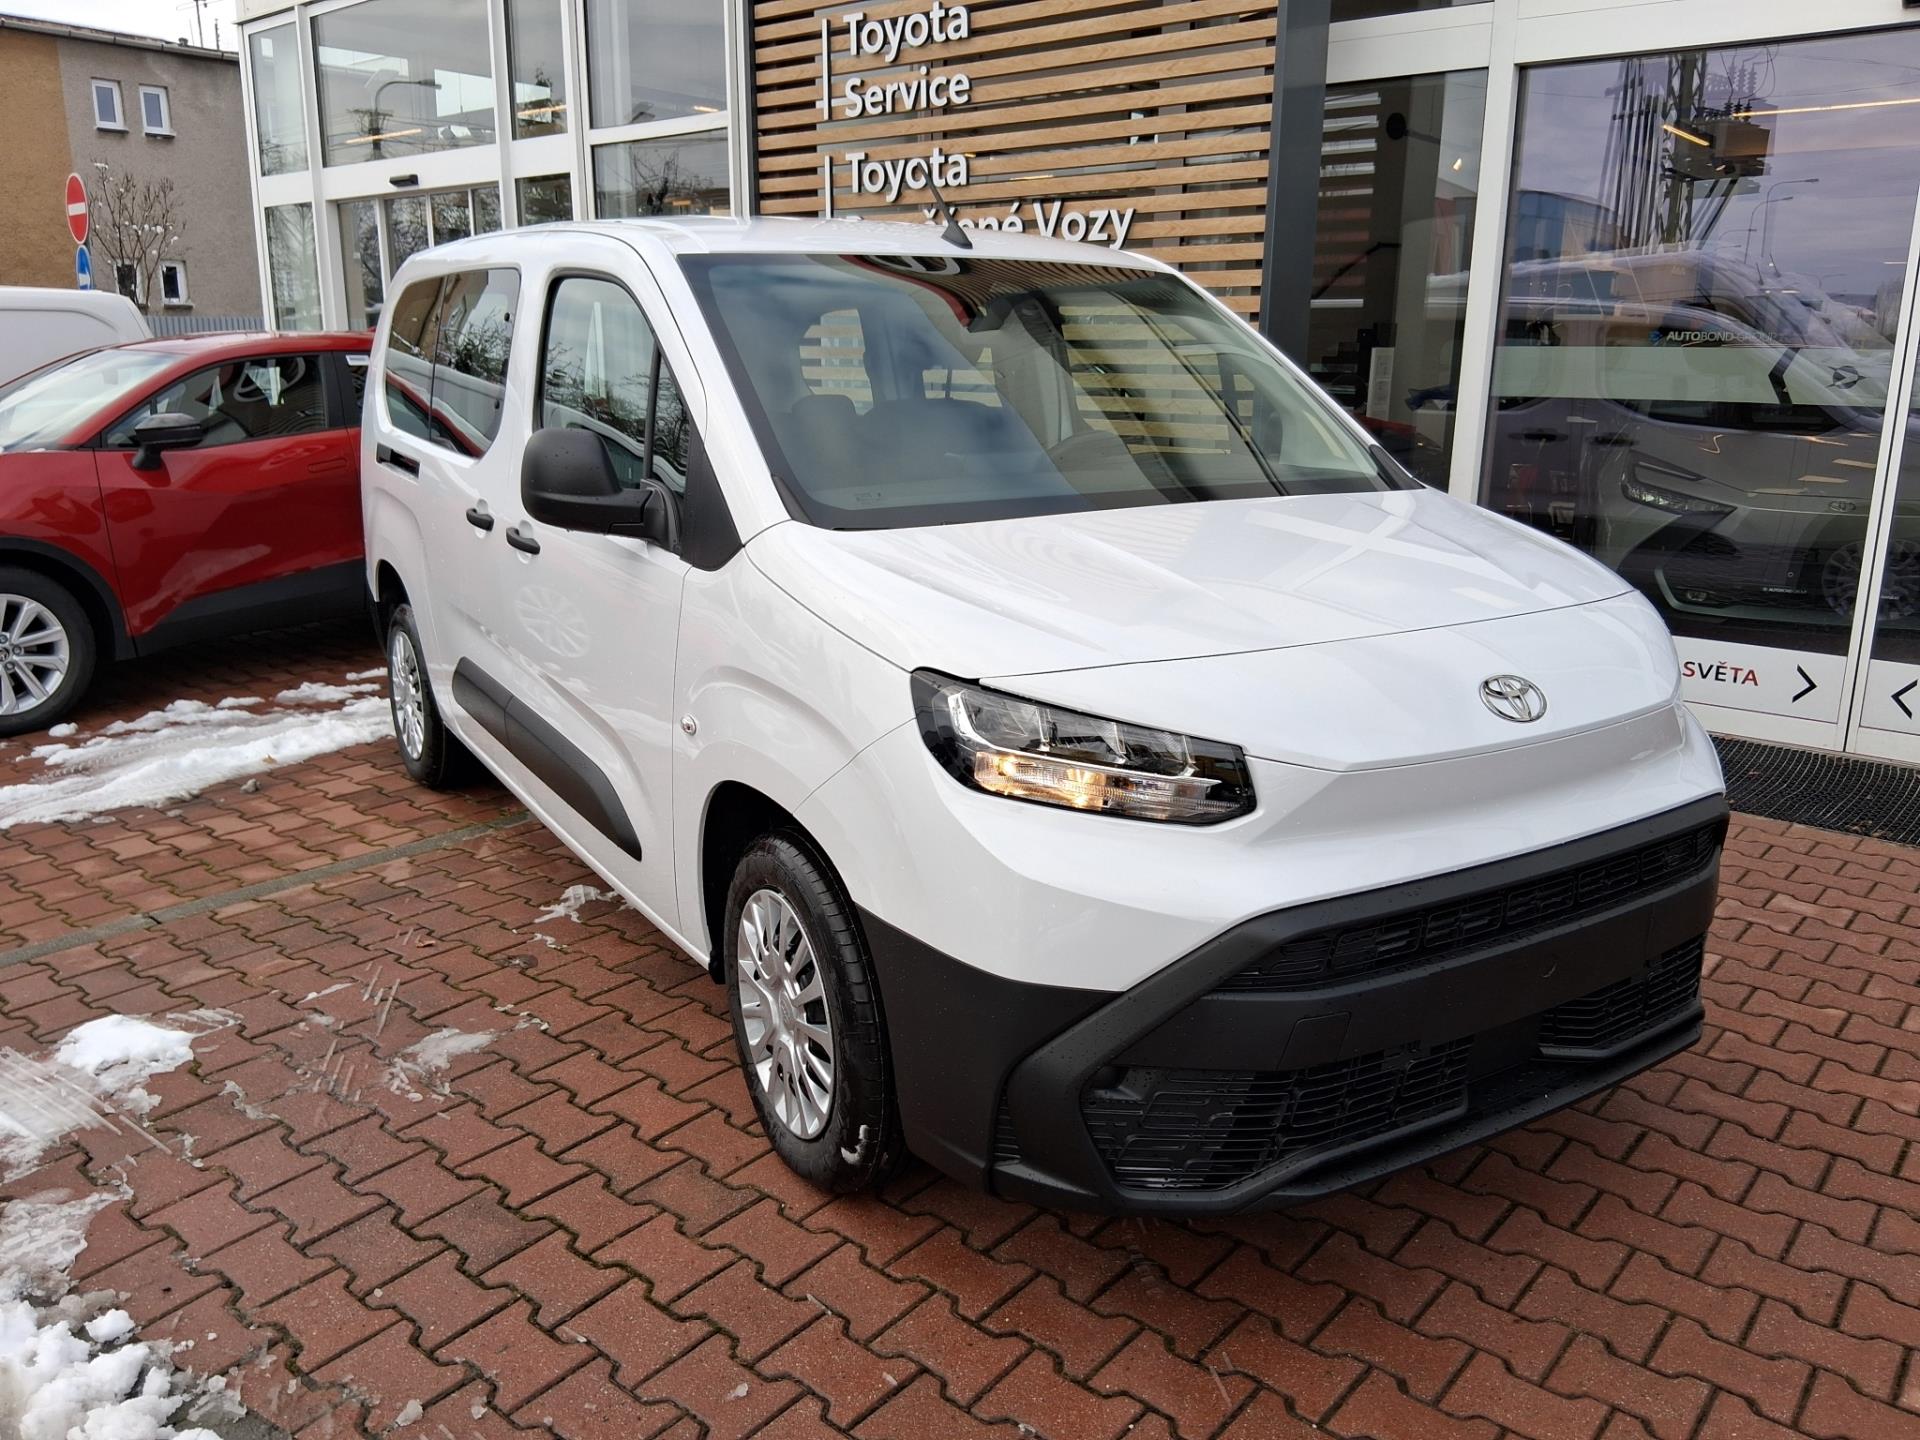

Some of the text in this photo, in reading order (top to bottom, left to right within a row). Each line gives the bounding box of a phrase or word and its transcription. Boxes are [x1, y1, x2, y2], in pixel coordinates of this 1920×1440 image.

[843, 1, 970, 62] Toyota
[845, 66, 970, 118] Service
[846, 148, 968, 202] Toyota
[1032, 200, 1135, 249] Vozy
[1682, 661, 1759, 686] SVĚTA
